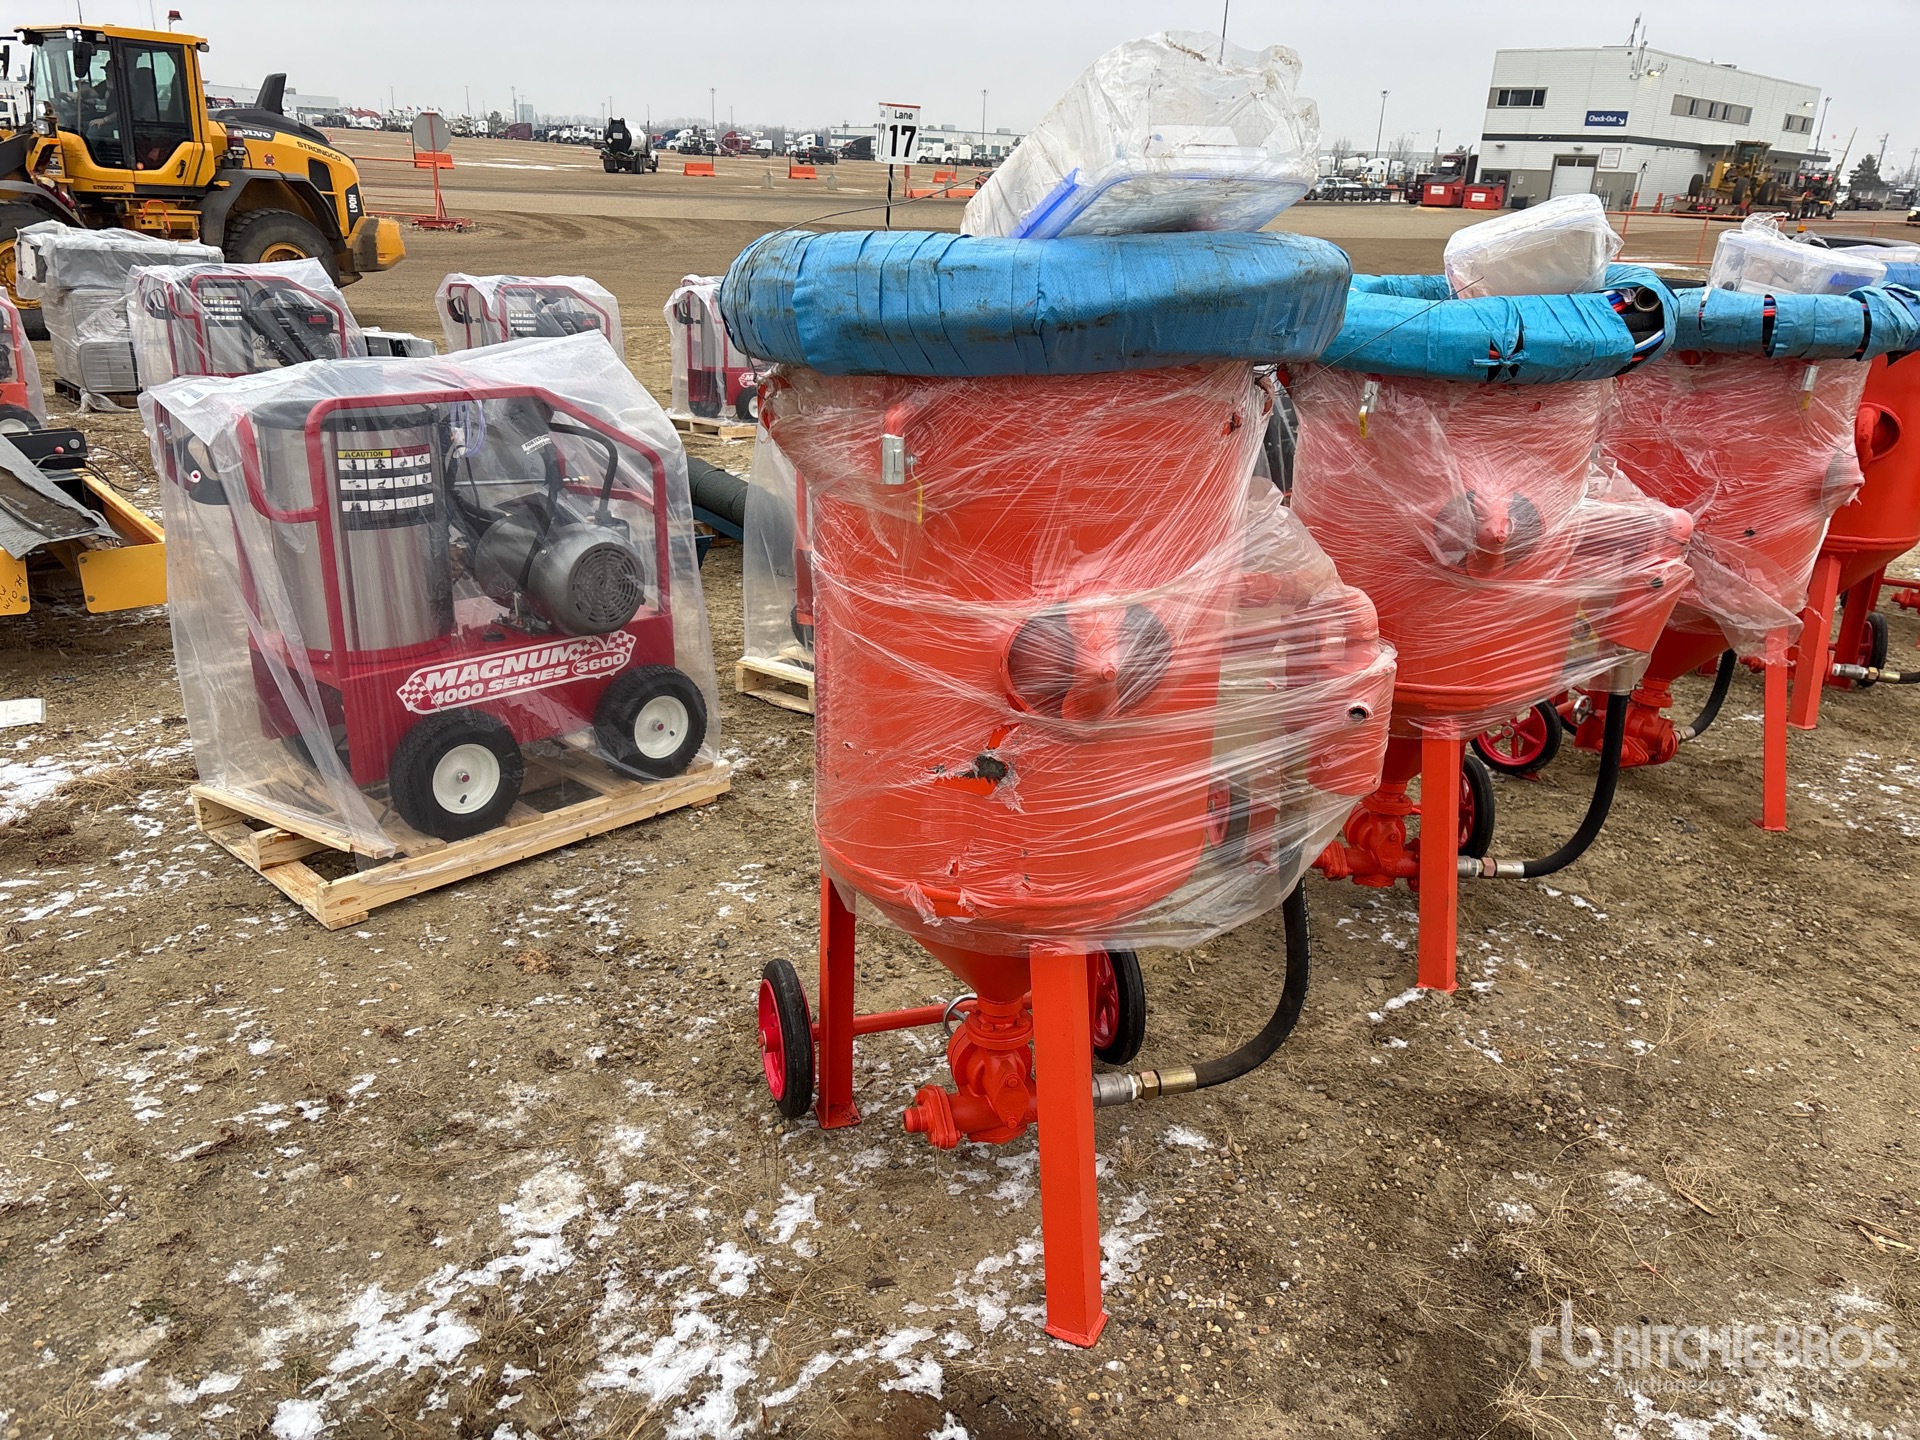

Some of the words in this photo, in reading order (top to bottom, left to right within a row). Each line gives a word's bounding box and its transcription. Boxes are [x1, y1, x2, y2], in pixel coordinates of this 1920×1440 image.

[894, 110, 913, 120] Lane
[297, 141, 341, 161] STRONGCO
[889, 125, 917, 157] 17
[348, 194, 358, 213] L90H
[351, 450, 384, 458] CAUTION
[425, 643, 581, 691] MAGNUM
[576, 653, 625, 674] 3600
[431, 682, 484, 705] 4000
[487, 665, 569, 692] SERIES
